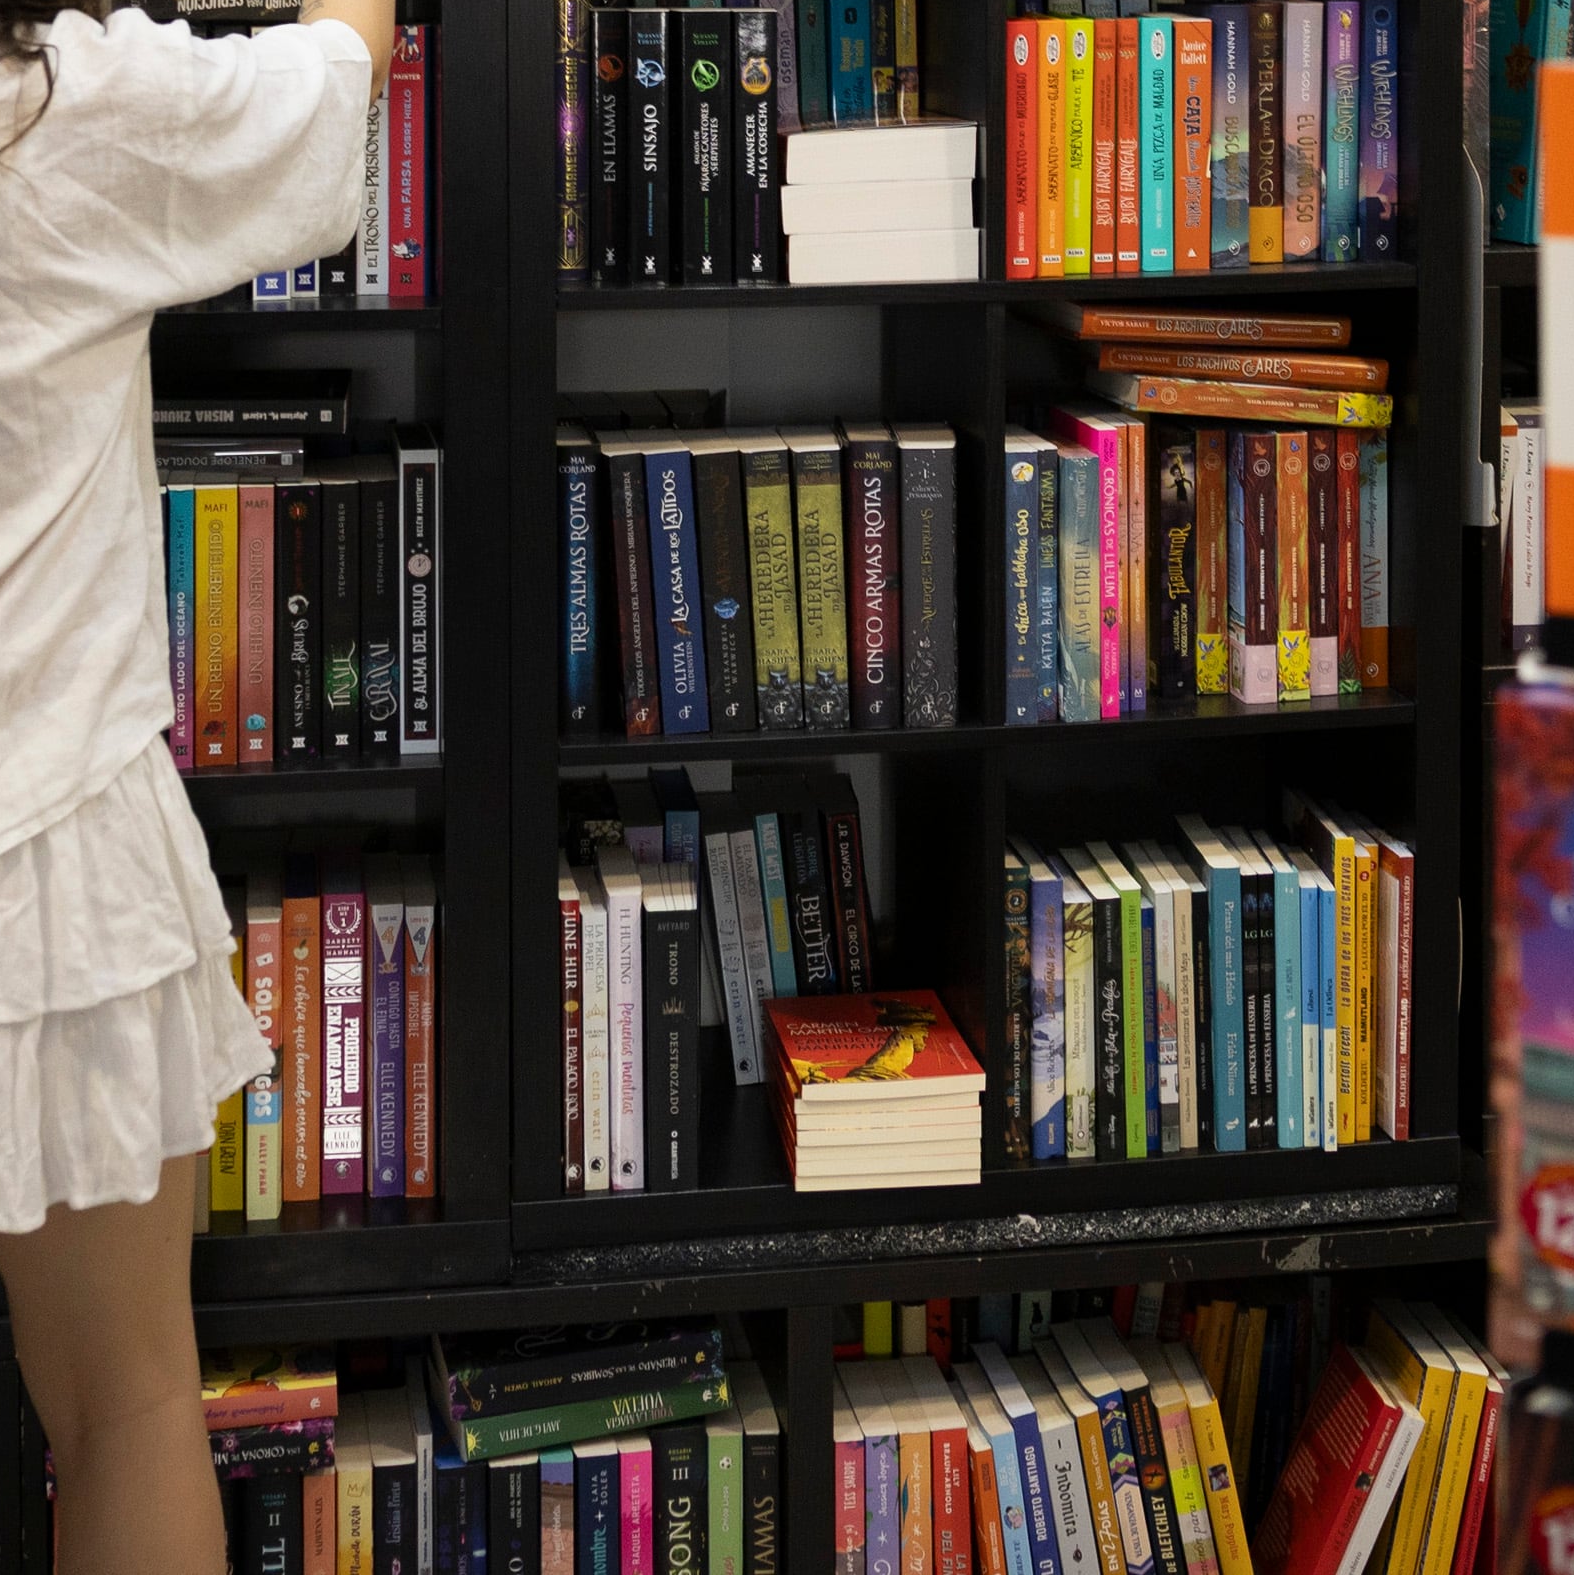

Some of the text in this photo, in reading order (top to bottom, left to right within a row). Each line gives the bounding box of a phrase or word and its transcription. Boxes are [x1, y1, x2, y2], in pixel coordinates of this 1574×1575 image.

[779, 30, 793, 84] oseman
[401, 89, 412, 228] UNA FARSA SOBRE HIELO
[603, 94, 616, 182] EN LLAMAS
[643, 104, 659, 172] SINSAJO
[700, 102, 711, 191] PÁJAROS CANTORES
[710, 117, 718, 171] SERPIENTES
[746, 114, 756, 176] AMANECER
[758, 102, 769, 188] EN LA COSECHA
[1152, 69, 1165, 181] UNA PIZCA MALDAD
[1095, 139, 1115, 226] RUBY FAIRYGALE
[1040, 469, 1056, 529] FANTASMA
[1103, 467, 1117, 536] CRÓNICAS
[570, 482, 588, 654] TRES ALMAS ROTAS
[753, 510, 776, 625] HEREDERA
[864, 477, 885, 684] CINCO ARMAS ROTAS
[1167, 522, 1191, 599] FABULANTOR
[175, 592, 185, 636] OCÉANO
[177, 639, 185, 658] DEL
[413, 584, 427, 693] ALMA DEL BRUJO
[1041, 586, 1054, 669] KATYA BALEN
[177, 662, 185, 690] LADO
[673, 642, 688, 694] OLIVIA
[178, 725, 185, 737] AL
[564, 910, 577, 989] JUNE HUR
[327, 1005, 342, 1107] ENAMORARSE
[344, 1016, 360, 1093] PROHIBIDO
[668, 941, 680, 1114] TRONO DESTROZADO
[1339, 1026, 1352, 1095] Bertolt Brecht
[380, 1061, 395, 1158] ELLE KENNEDY
[1024, 1446, 1047, 1541] ROBERTO SANTIAGO
[1151, 1495, 1174, 1560] BLETCHLEY
